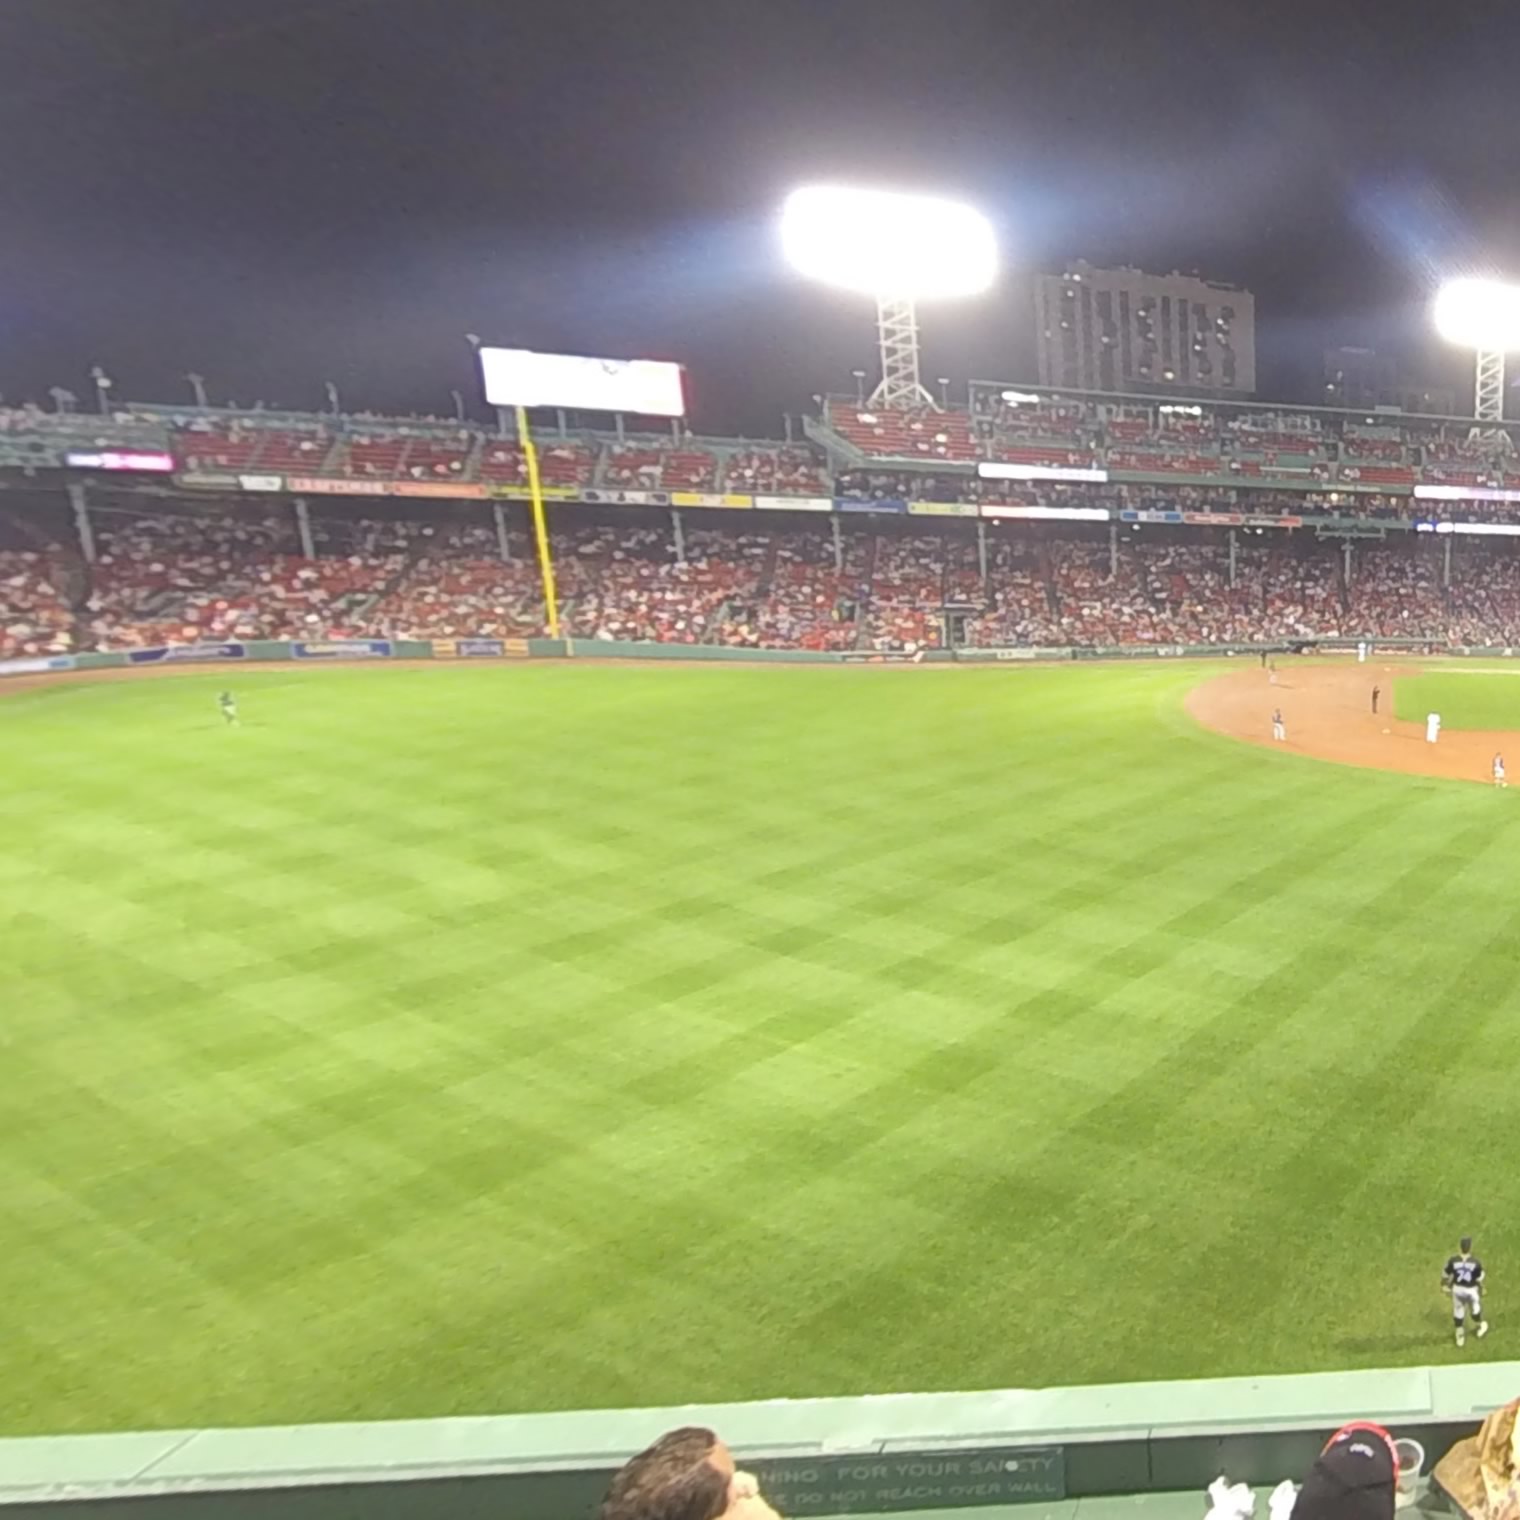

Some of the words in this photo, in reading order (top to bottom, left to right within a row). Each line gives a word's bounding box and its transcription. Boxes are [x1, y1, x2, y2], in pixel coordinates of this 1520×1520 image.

[760, 1469, 819, 1484] NING
[838, 1465, 889, 1481] FOR
[895, 1462, 960, 1478] YOUR
[794, 1492, 824, 1505] DO
[830, 1489, 867, 1502] NOT
[876, 1486, 943, 1500] REACH
[948, 1482, 1001, 1497] OVER
[1007, 1480, 1058, 1493] WALL
